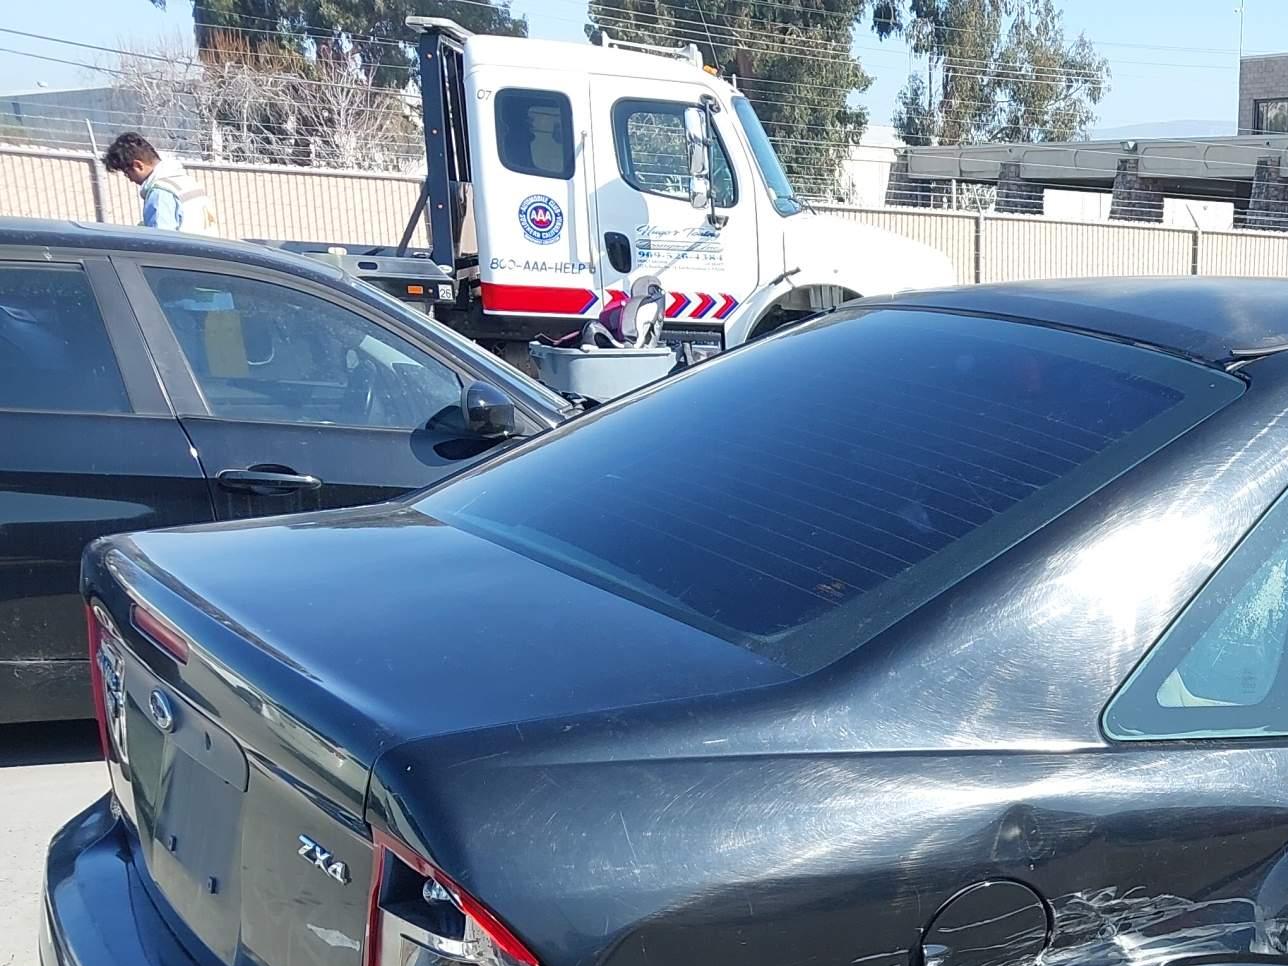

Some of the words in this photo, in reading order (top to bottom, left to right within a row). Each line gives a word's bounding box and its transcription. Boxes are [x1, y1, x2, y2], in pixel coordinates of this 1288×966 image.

[477, 89, 492, 101] 07
[530, 208, 552, 222] AAA
[439, 288, 452, 299] 26
[297, 834, 352, 886] ZX4
